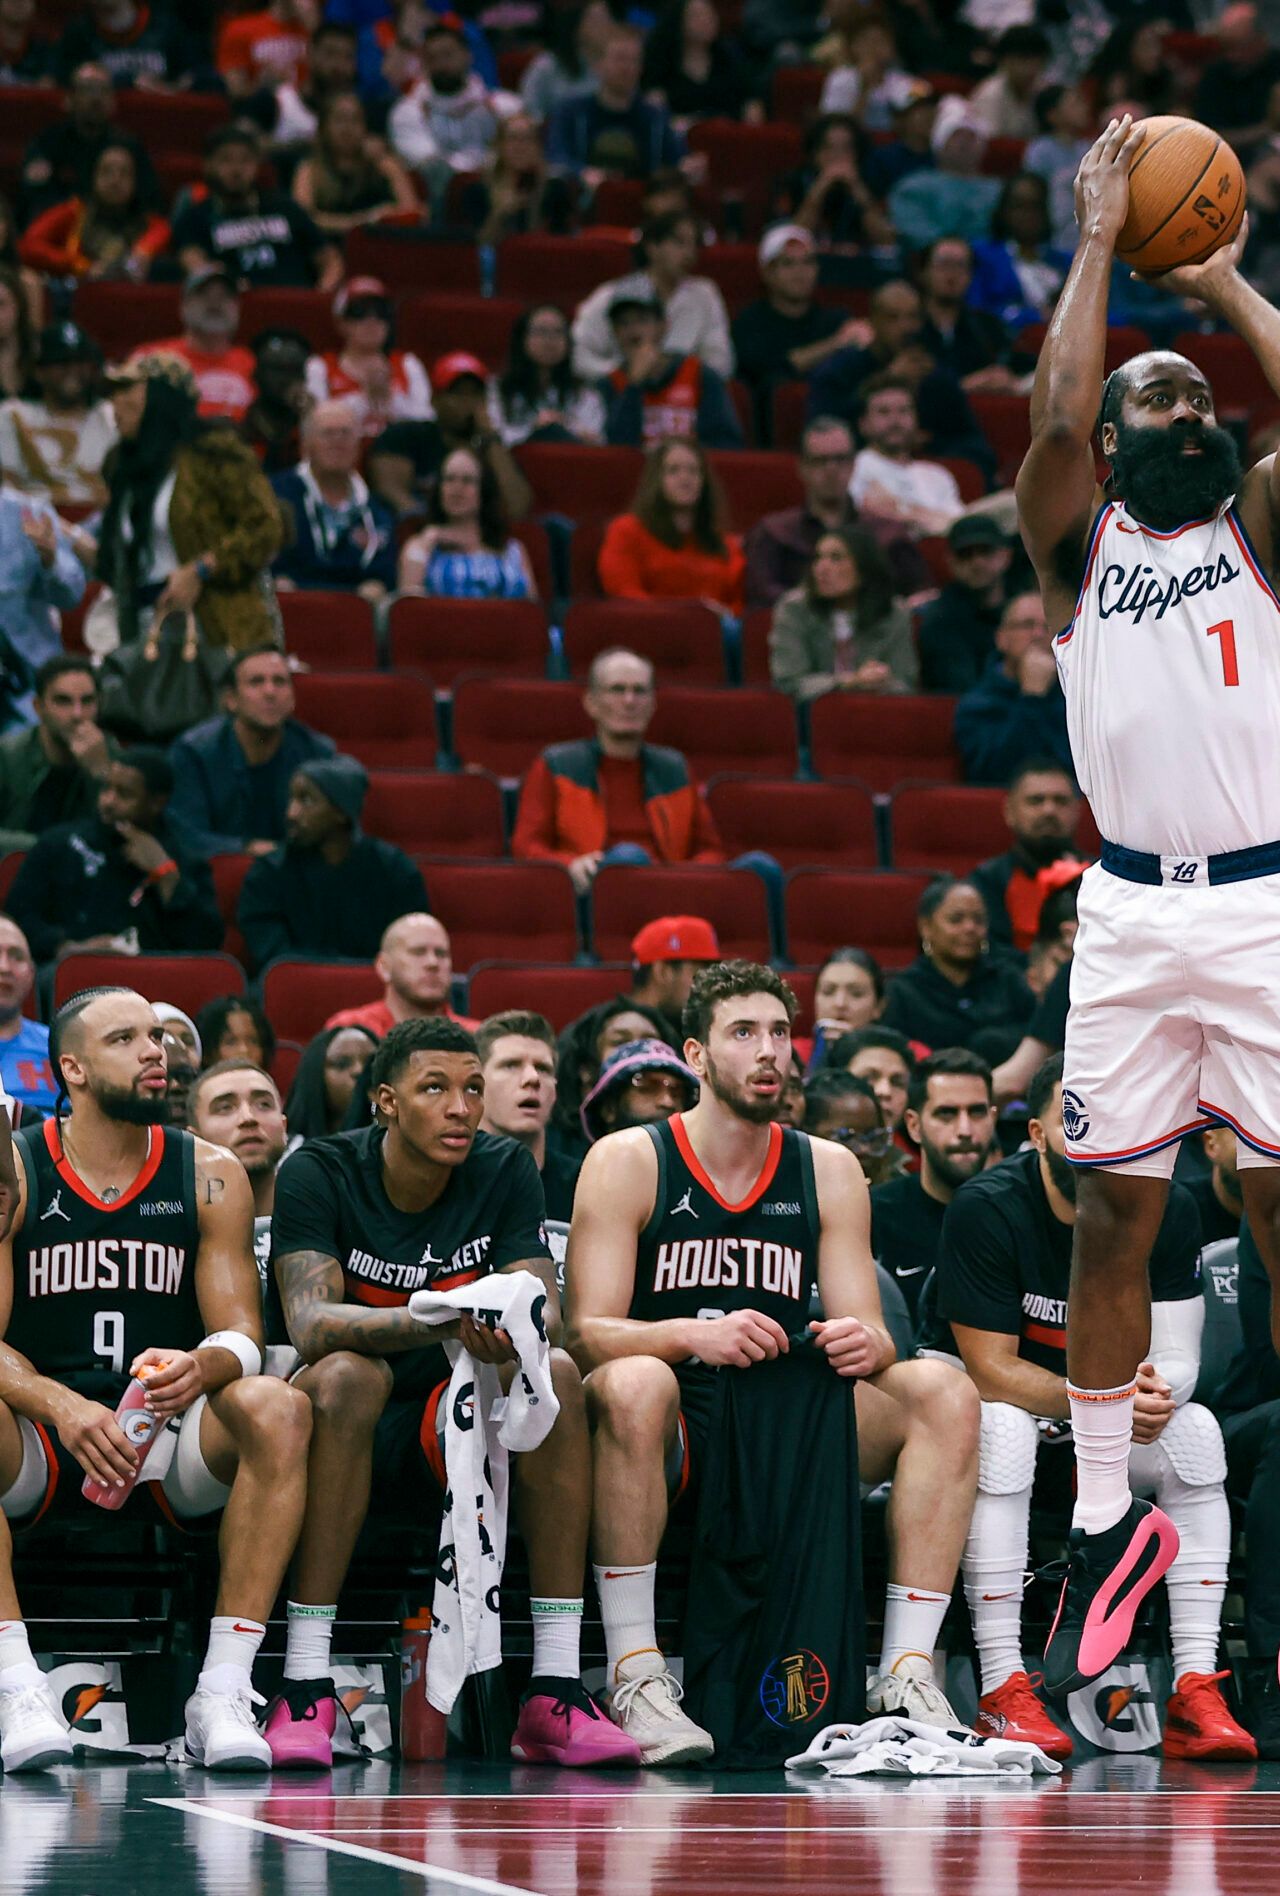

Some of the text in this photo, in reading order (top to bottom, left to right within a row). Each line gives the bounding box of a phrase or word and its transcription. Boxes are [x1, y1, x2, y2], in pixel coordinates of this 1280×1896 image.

[1098, 553, 1240, 625] Clippers
[1206, 619, 1239, 687] 1
[28, 1238, 186, 1298] HOUSTON
[347, 1248, 428, 1289] HOUSTON
[652, 1237, 803, 1301] HOUSTON
[1021, 1291, 1067, 1325] HOUST
[93, 1310, 124, 1374] 9
[1066, 1663, 1163, 1752] G
